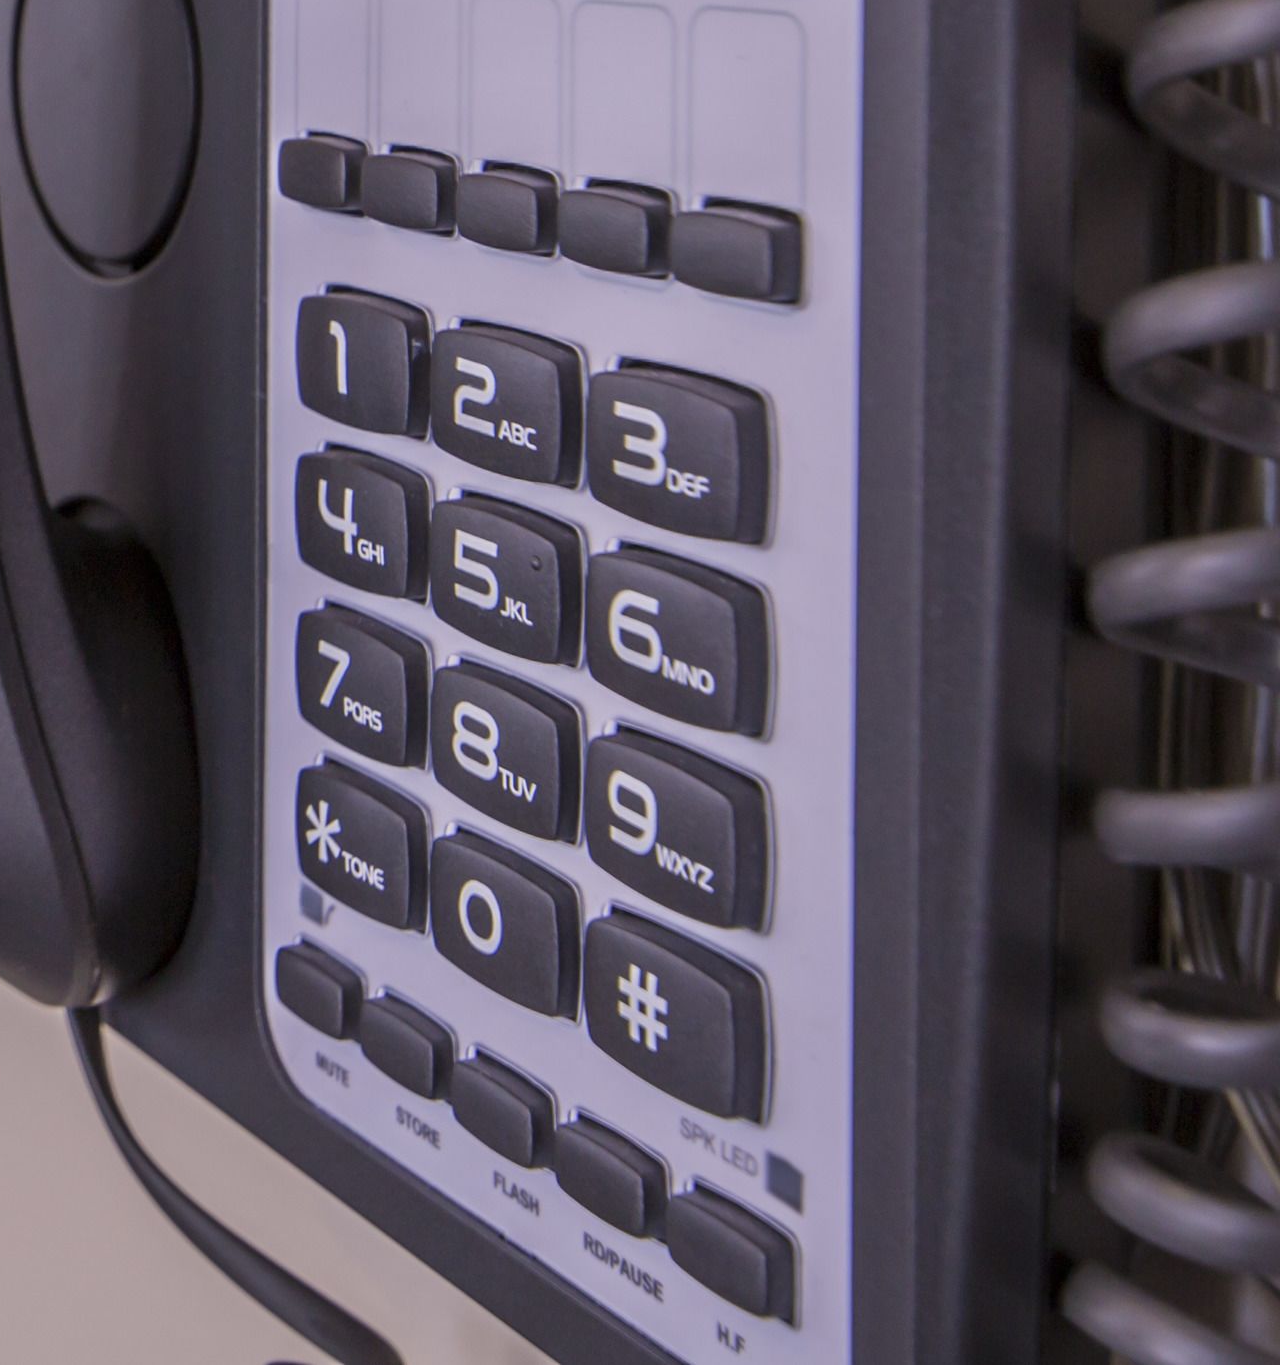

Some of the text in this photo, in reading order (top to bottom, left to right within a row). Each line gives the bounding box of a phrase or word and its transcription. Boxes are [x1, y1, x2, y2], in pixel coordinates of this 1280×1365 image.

[329, 320, 348, 395] 1
[453, 356, 538, 451] 2 ABC
[612, 400, 710, 499] 3 DEF
[318, 478, 385, 566] 4 GHI
[453, 528, 534, 627] 5 JKL
[318, 639, 383, 732] 7 PQRS
[608, 589, 715, 695] 6 MNO
[452, 700, 537, 803] 8 TUV
[341, 850, 385, 891] TONE
[607, 769, 714, 893] 9 WXYZ
[315, 1051, 351, 1088] MUTE
[396, 1105, 441, 1150] STORE
[680, 1116, 759, 1177] SPK LED
[493, 1170, 540, 1216] FLASH
[583, 1231, 665, 1303] RD/PAUSE
